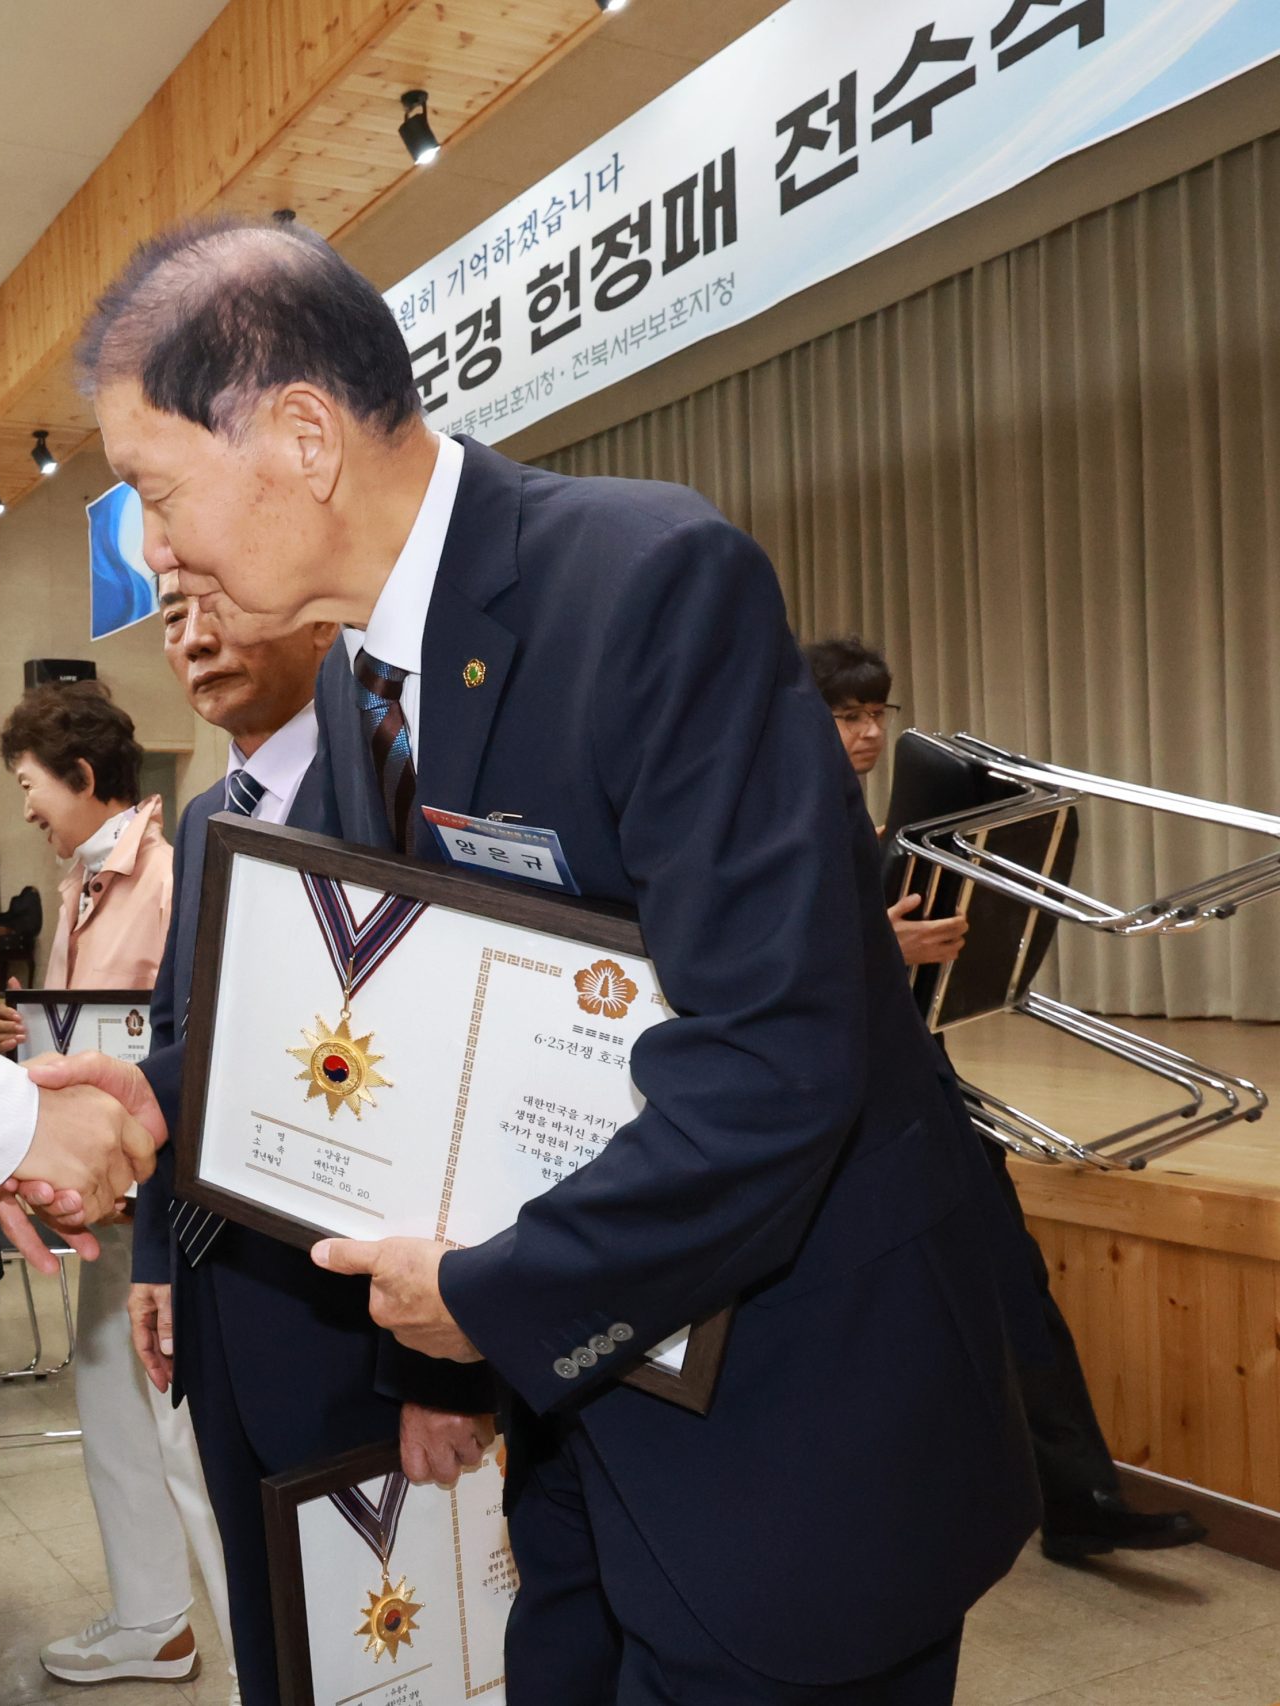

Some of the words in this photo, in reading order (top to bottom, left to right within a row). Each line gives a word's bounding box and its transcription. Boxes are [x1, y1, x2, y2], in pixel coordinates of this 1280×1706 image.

[391, 280, 435, 331] 원히
[447, 152, 625, 298] 기억하겠습니다
[410, 296, 502, 413] 군경
[526, 147, 738, 355] 헌정패
[572, 272, 735, 380] 전북서부보훈지청
[455, 839, 477, 856] 양
[487, 847, 510, 863] 은
[520, 854, 543, 871] 규
[534, 1033, 593, 1060] 6·25전쟁
[597, 1050, 630, 1070] 호국
[515, 1109, 548, 1128] 생명을
[551, 1121, 585, 1140] 바치신
[523, 1095, 579, 1121] 대한민국을
[583, 1114, 618, 1132] 지키기
[252, 1149, 282, 1167] 생년월일
[499, 1121, 532, 1139] 국가가
[536, 1132, 568, 1151] 영원히
[573, 1145, 601, 1161] 기억
[515, 1143, 527, 1154] 그
[531, 1147, 564, 1167] 마음을
[314, 1159, 346, 1178] 대한민국
[541, 1168, 567, 1183] 헌정
